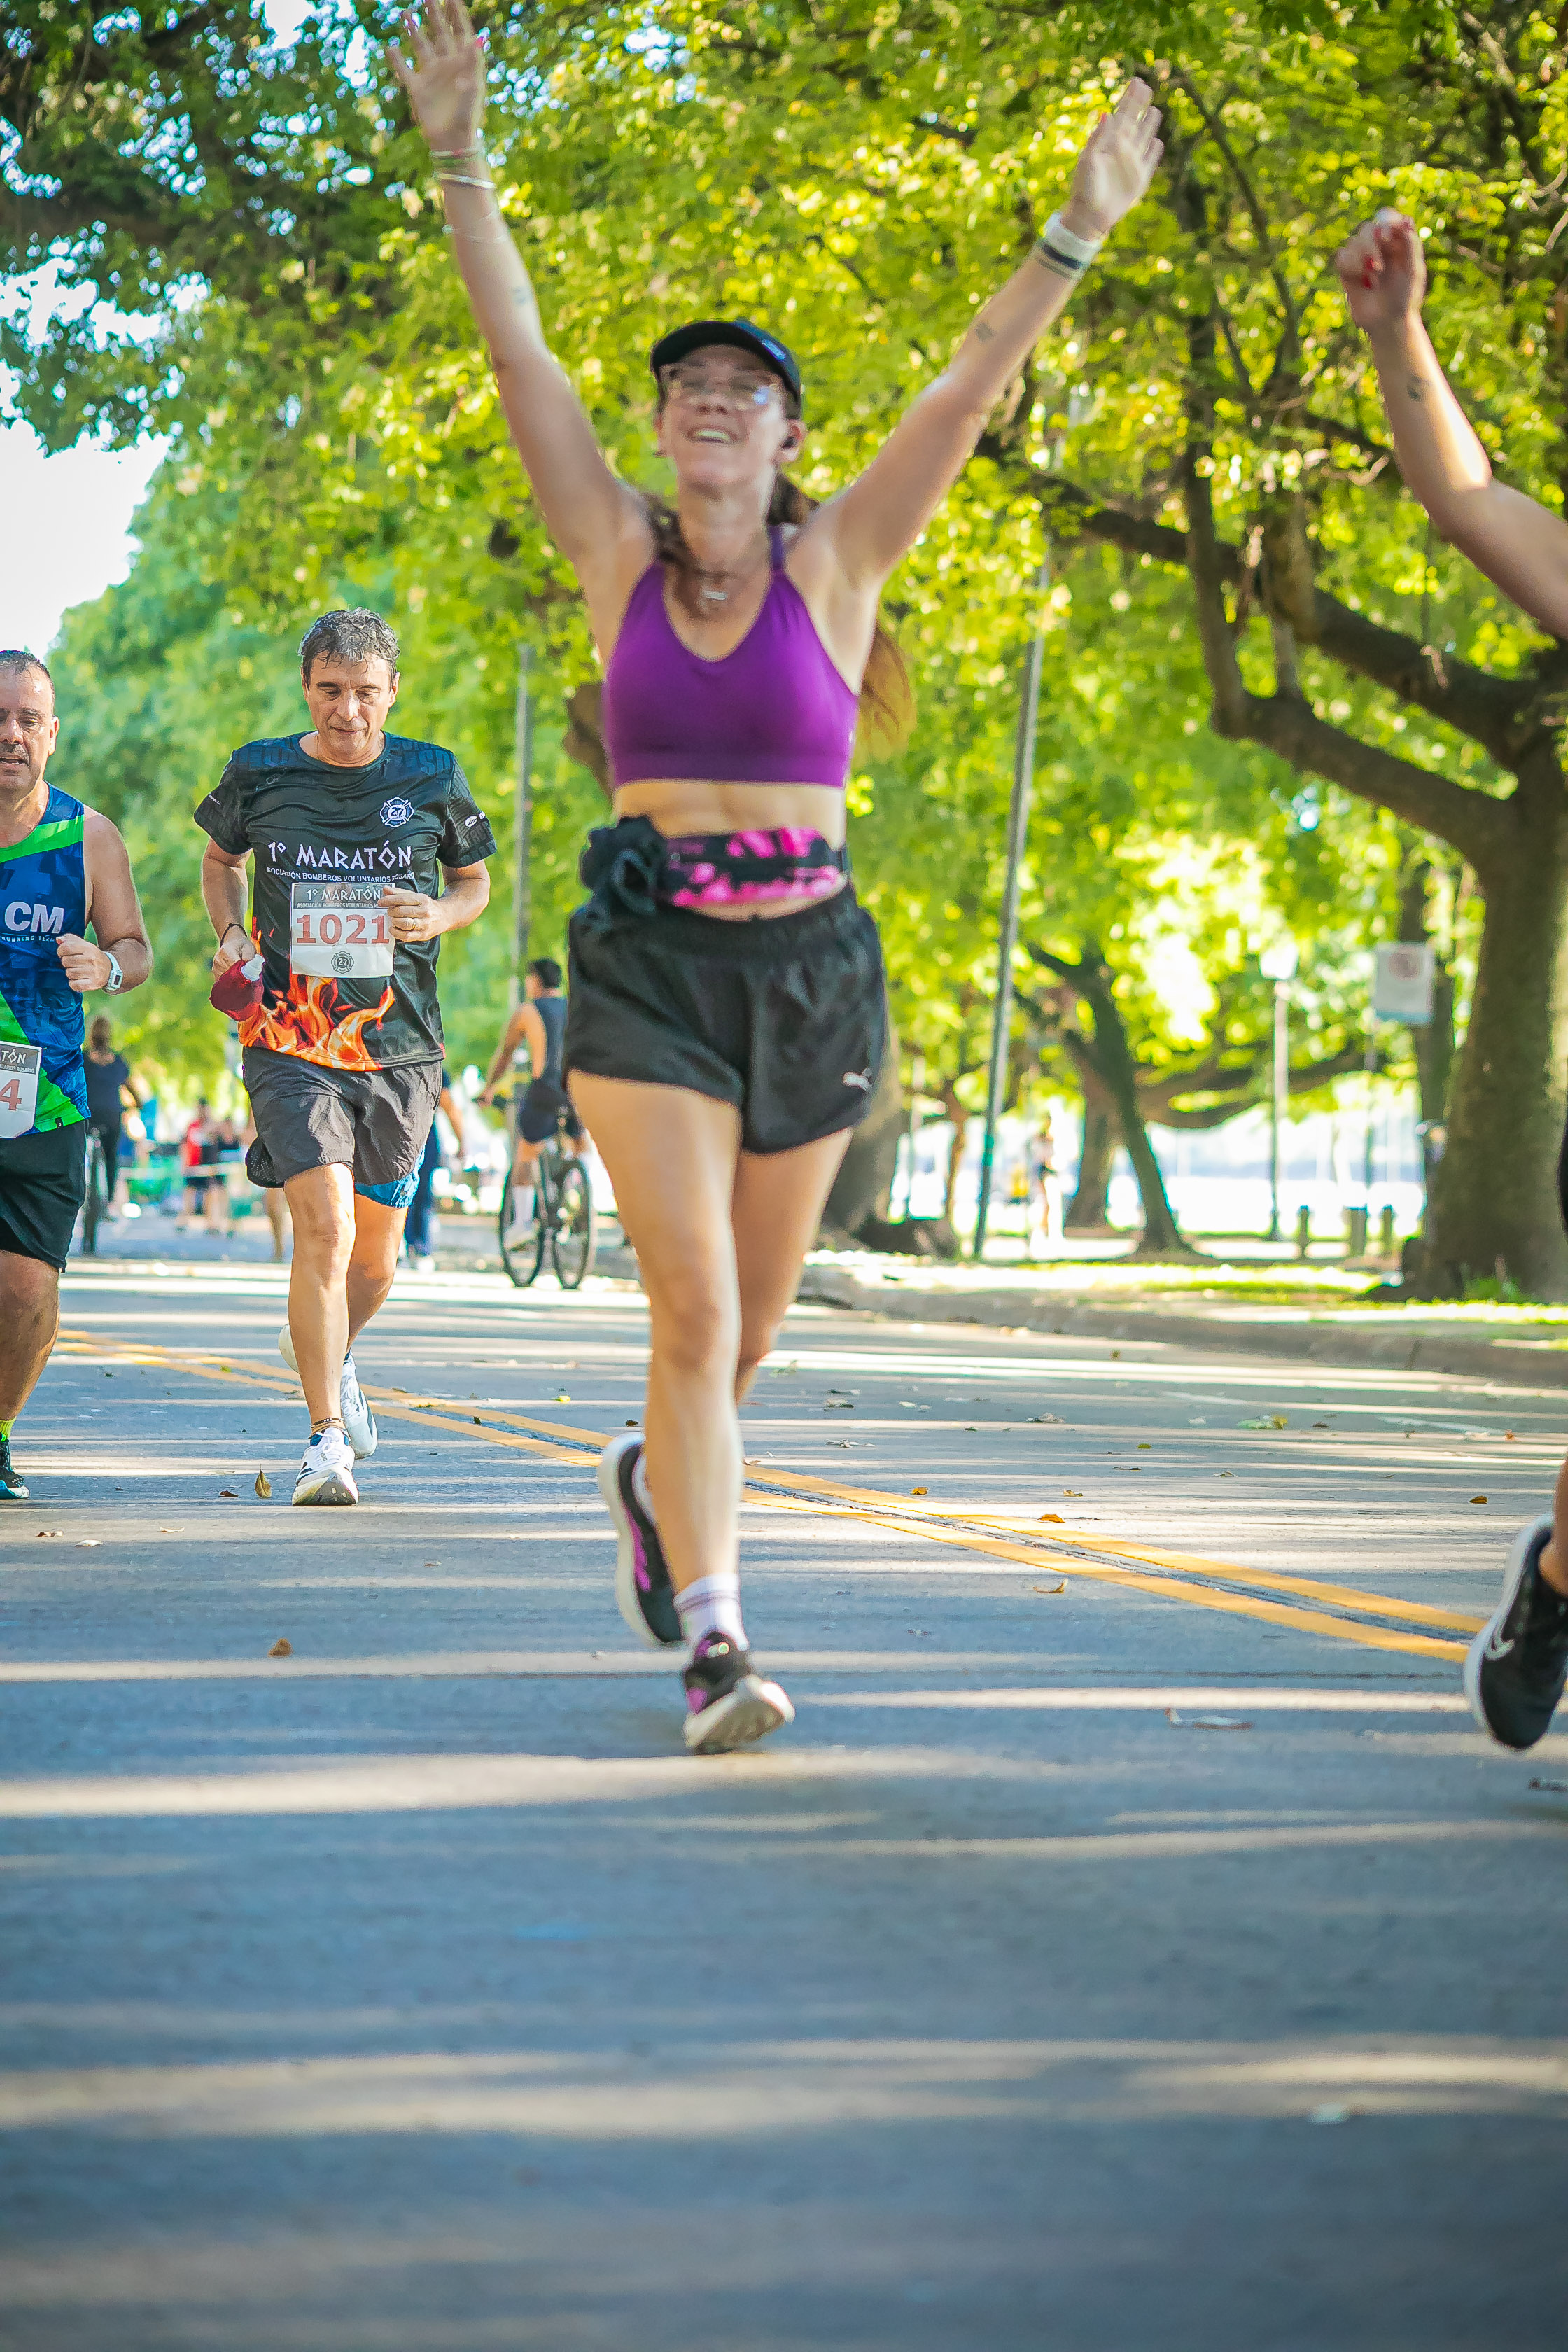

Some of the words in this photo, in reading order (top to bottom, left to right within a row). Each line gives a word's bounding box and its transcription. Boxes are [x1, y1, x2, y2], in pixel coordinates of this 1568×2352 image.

[296, 840, 412, 869] MARATÓN
[302, 872, 342, 881] BOMBEROS
[321, 885, 381, 901] MARATÓN
[5, 901, 64, 934] CM
[297, 913, 390, 944] 1021
[338, 958, 348, 966] 27
[0, 1079, 22, 1110] 4
